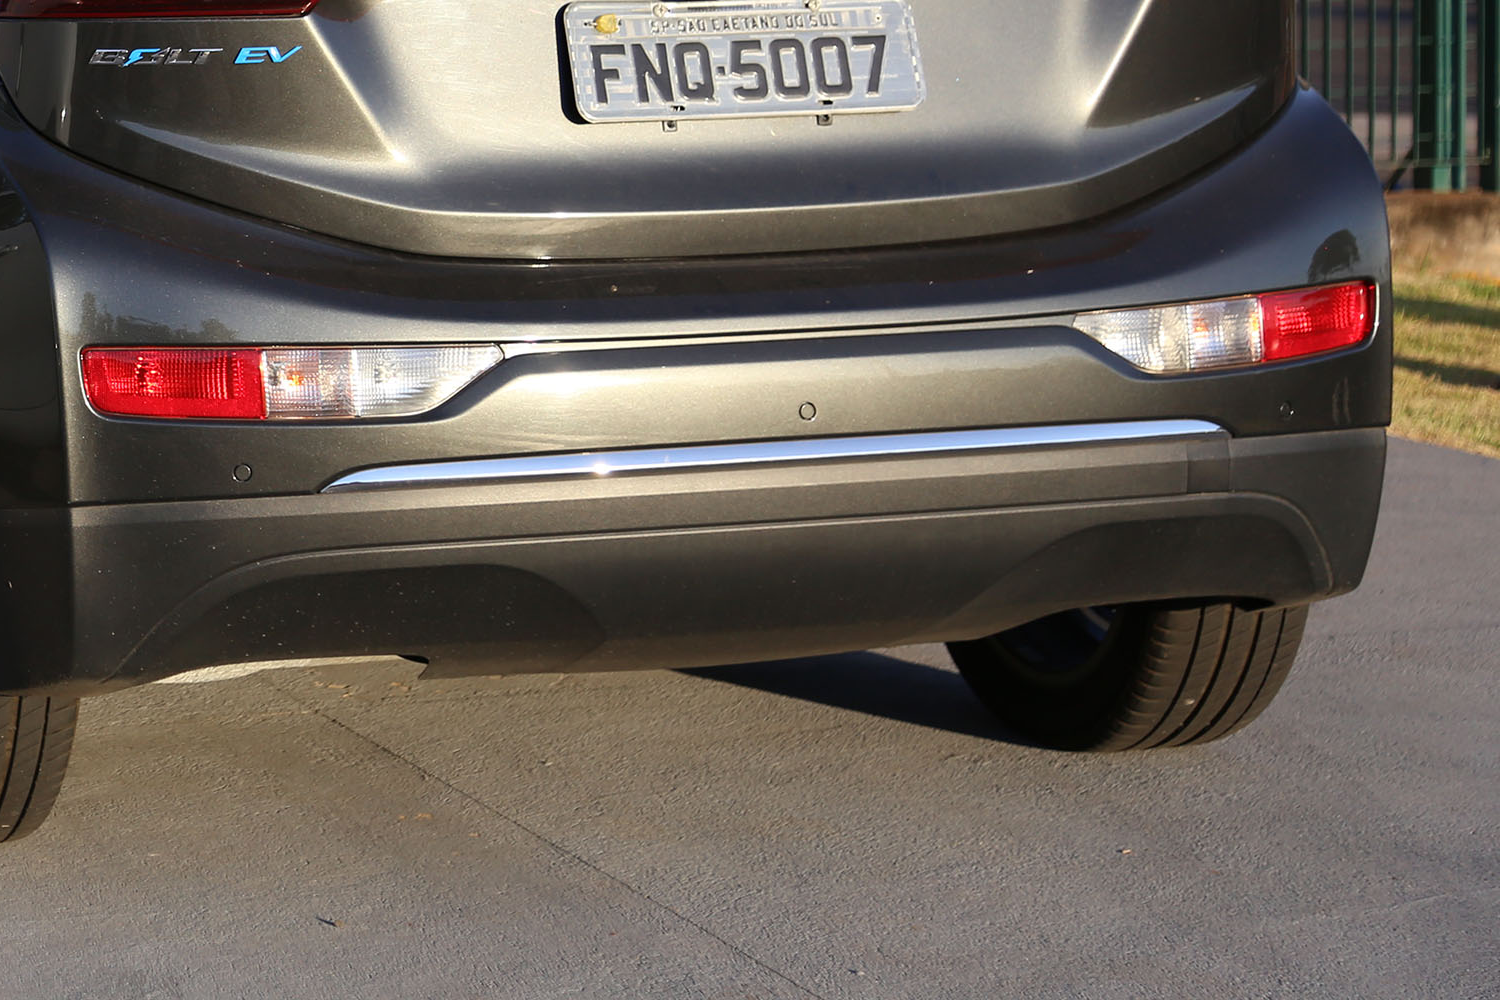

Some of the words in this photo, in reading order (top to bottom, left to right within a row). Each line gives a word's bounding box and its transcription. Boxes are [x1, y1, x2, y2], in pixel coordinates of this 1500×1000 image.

[712, 14, 779, 32] CAETANO
[809, 12, 839, 28] SUL
[88, 46, 224, 67] BOLT
[233, 45, 303, 65] EV
